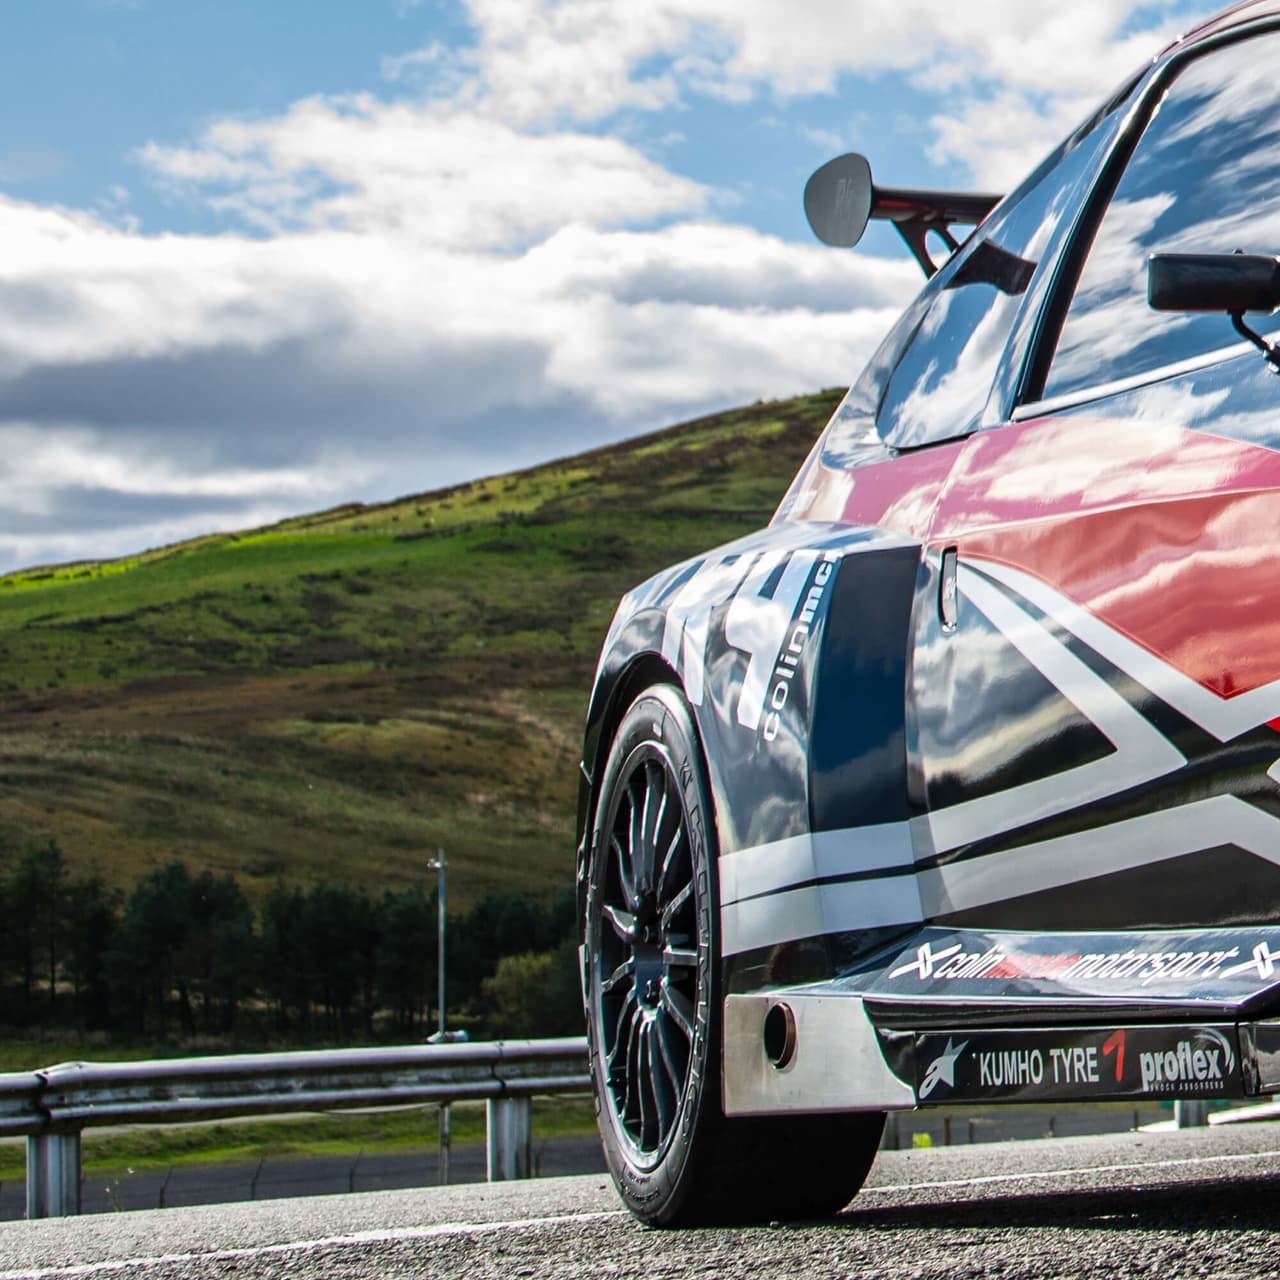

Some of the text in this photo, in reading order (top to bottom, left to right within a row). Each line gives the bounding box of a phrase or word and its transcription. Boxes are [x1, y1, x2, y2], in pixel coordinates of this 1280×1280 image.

[979, 1046, 1100, 1087] KUMHO TYRE
[1139, 1040, 1223, 1092] proflex
